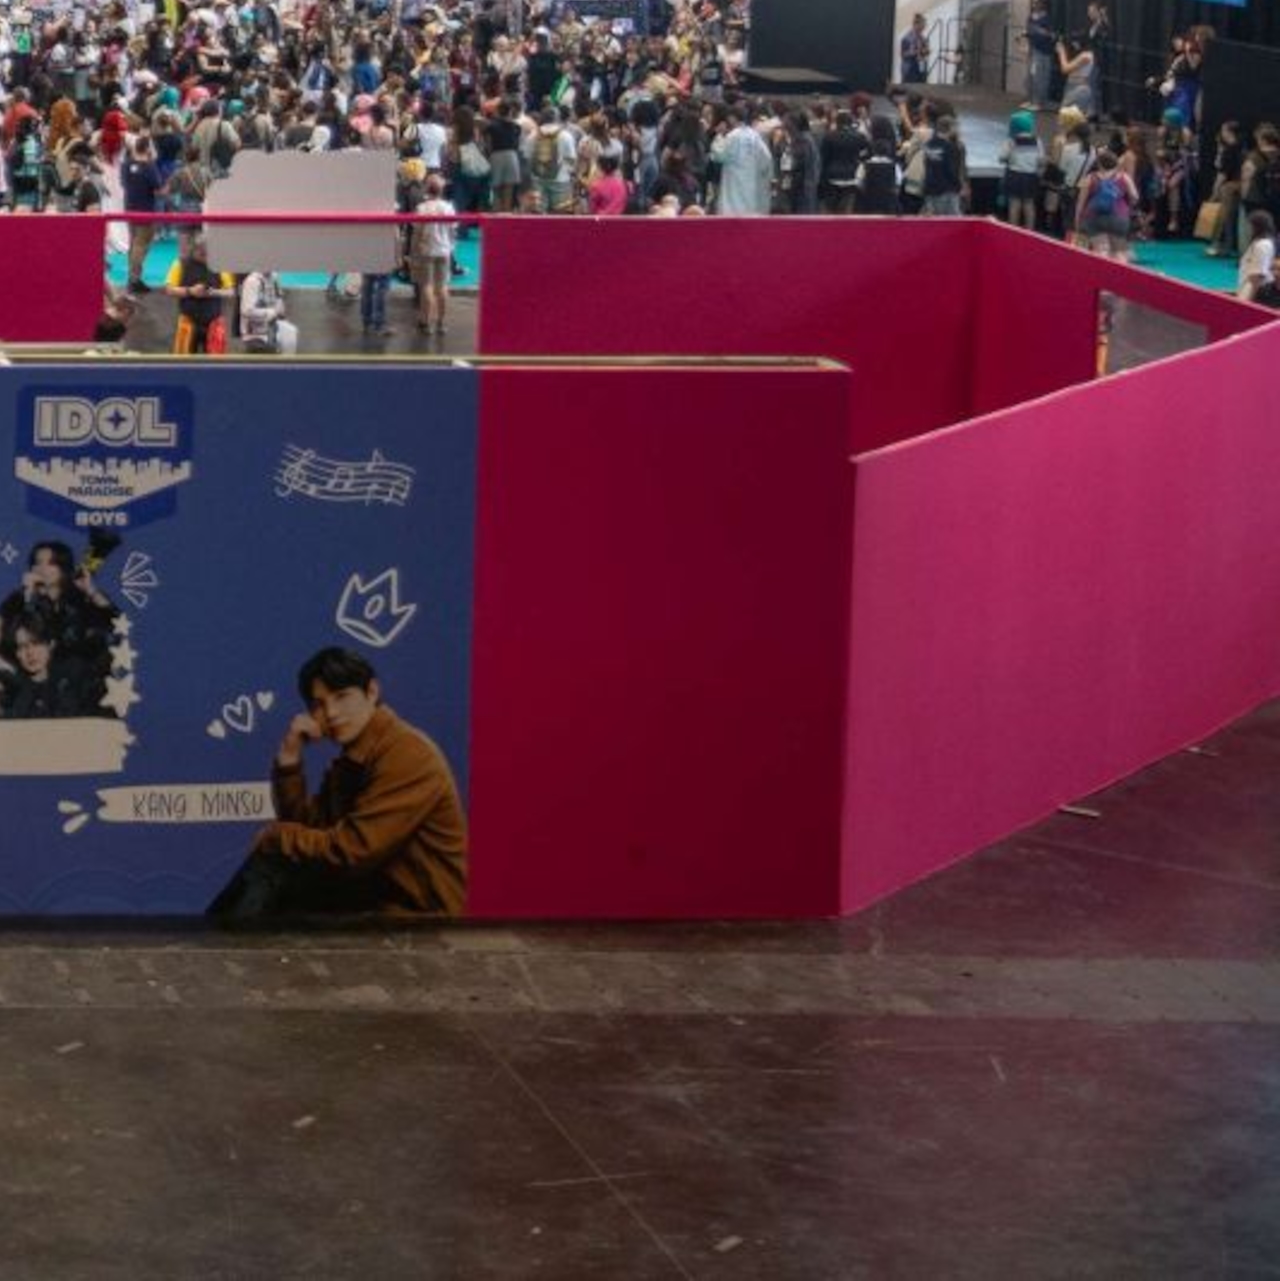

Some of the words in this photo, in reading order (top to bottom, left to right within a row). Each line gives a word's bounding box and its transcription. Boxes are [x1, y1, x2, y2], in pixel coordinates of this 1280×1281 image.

[34, 396, 178, 448] IDOL
[79, 475, 119, 486] TOWN
[68, 486, 135, 497] PARADISE
[74, 511, 129, 526] BOYS
[131, 791, 187, 818] KANG
[201, 790, 265, 817] MINSU
